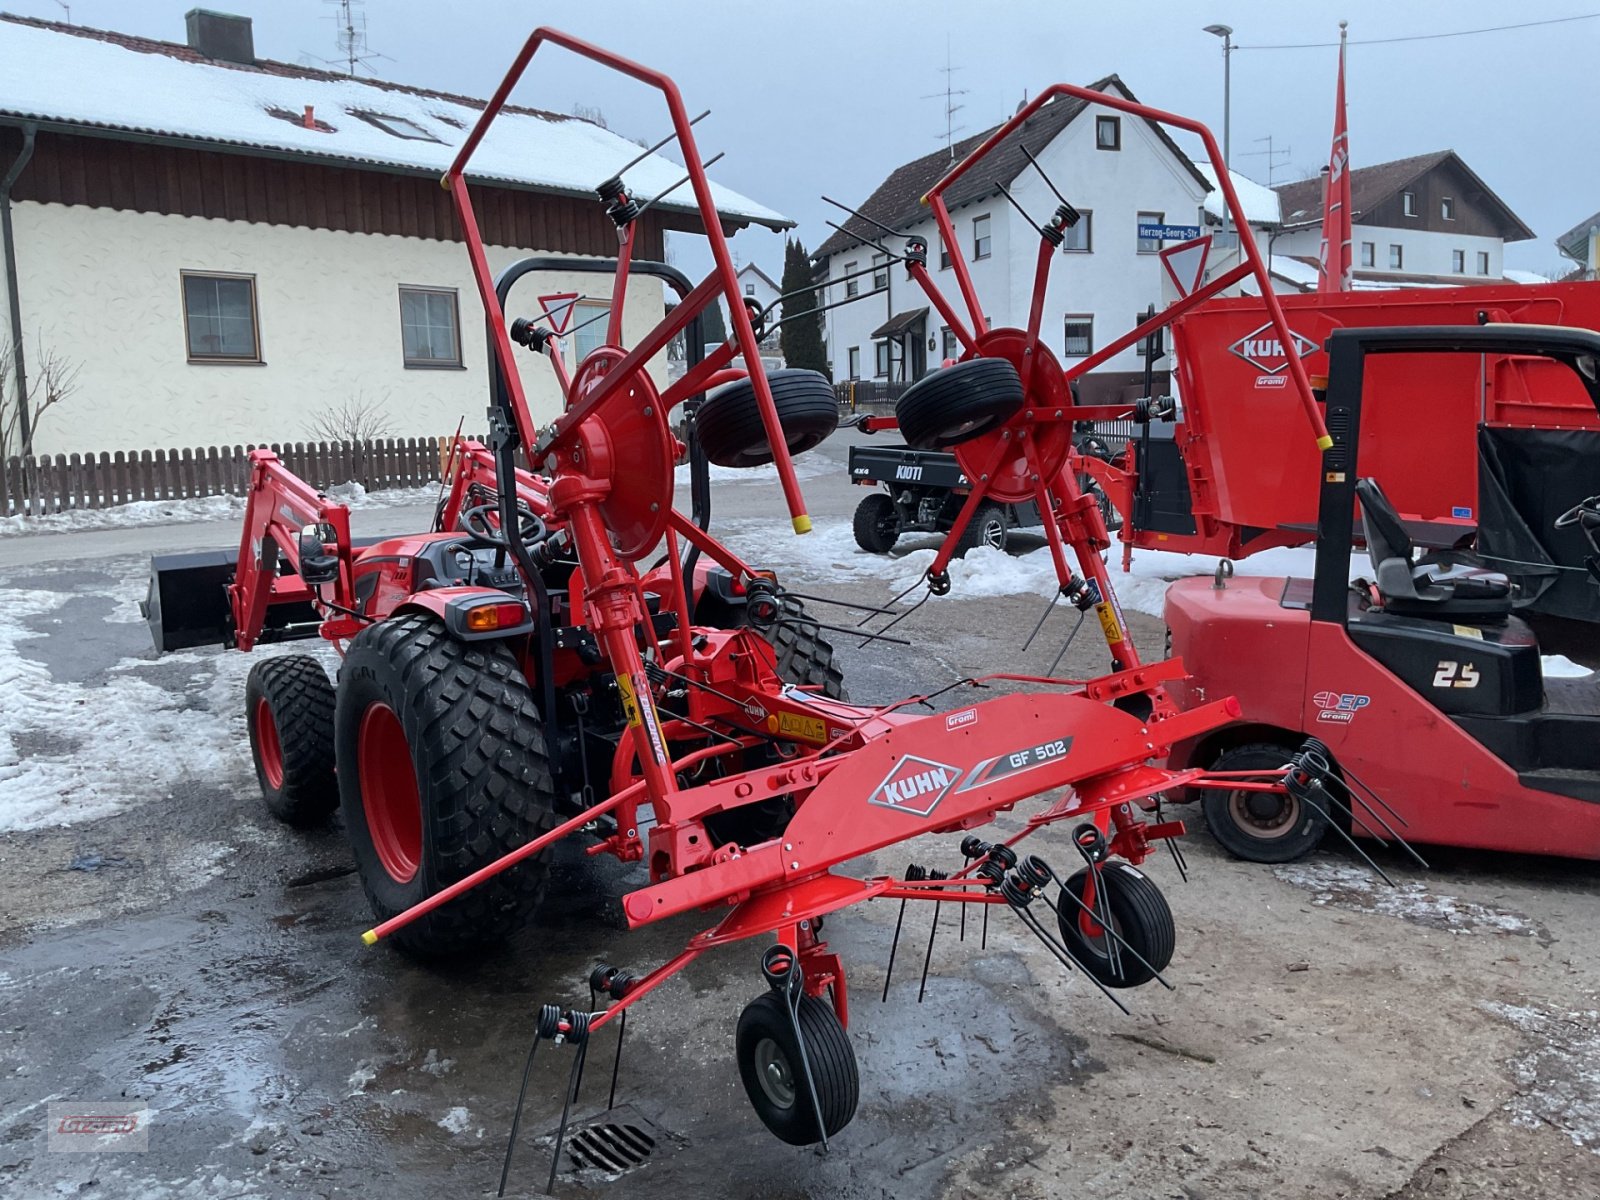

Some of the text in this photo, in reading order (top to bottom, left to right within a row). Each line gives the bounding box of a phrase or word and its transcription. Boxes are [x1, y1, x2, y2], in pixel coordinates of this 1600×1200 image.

[896, 465, 923, 481] KIOTI
[1433, 660, 1480, 688] 25
[1337, 694, 1371, 711] EP
[1009, 740, 1067, 768] GF 502
[884, 767, 951, 805] KUHN
